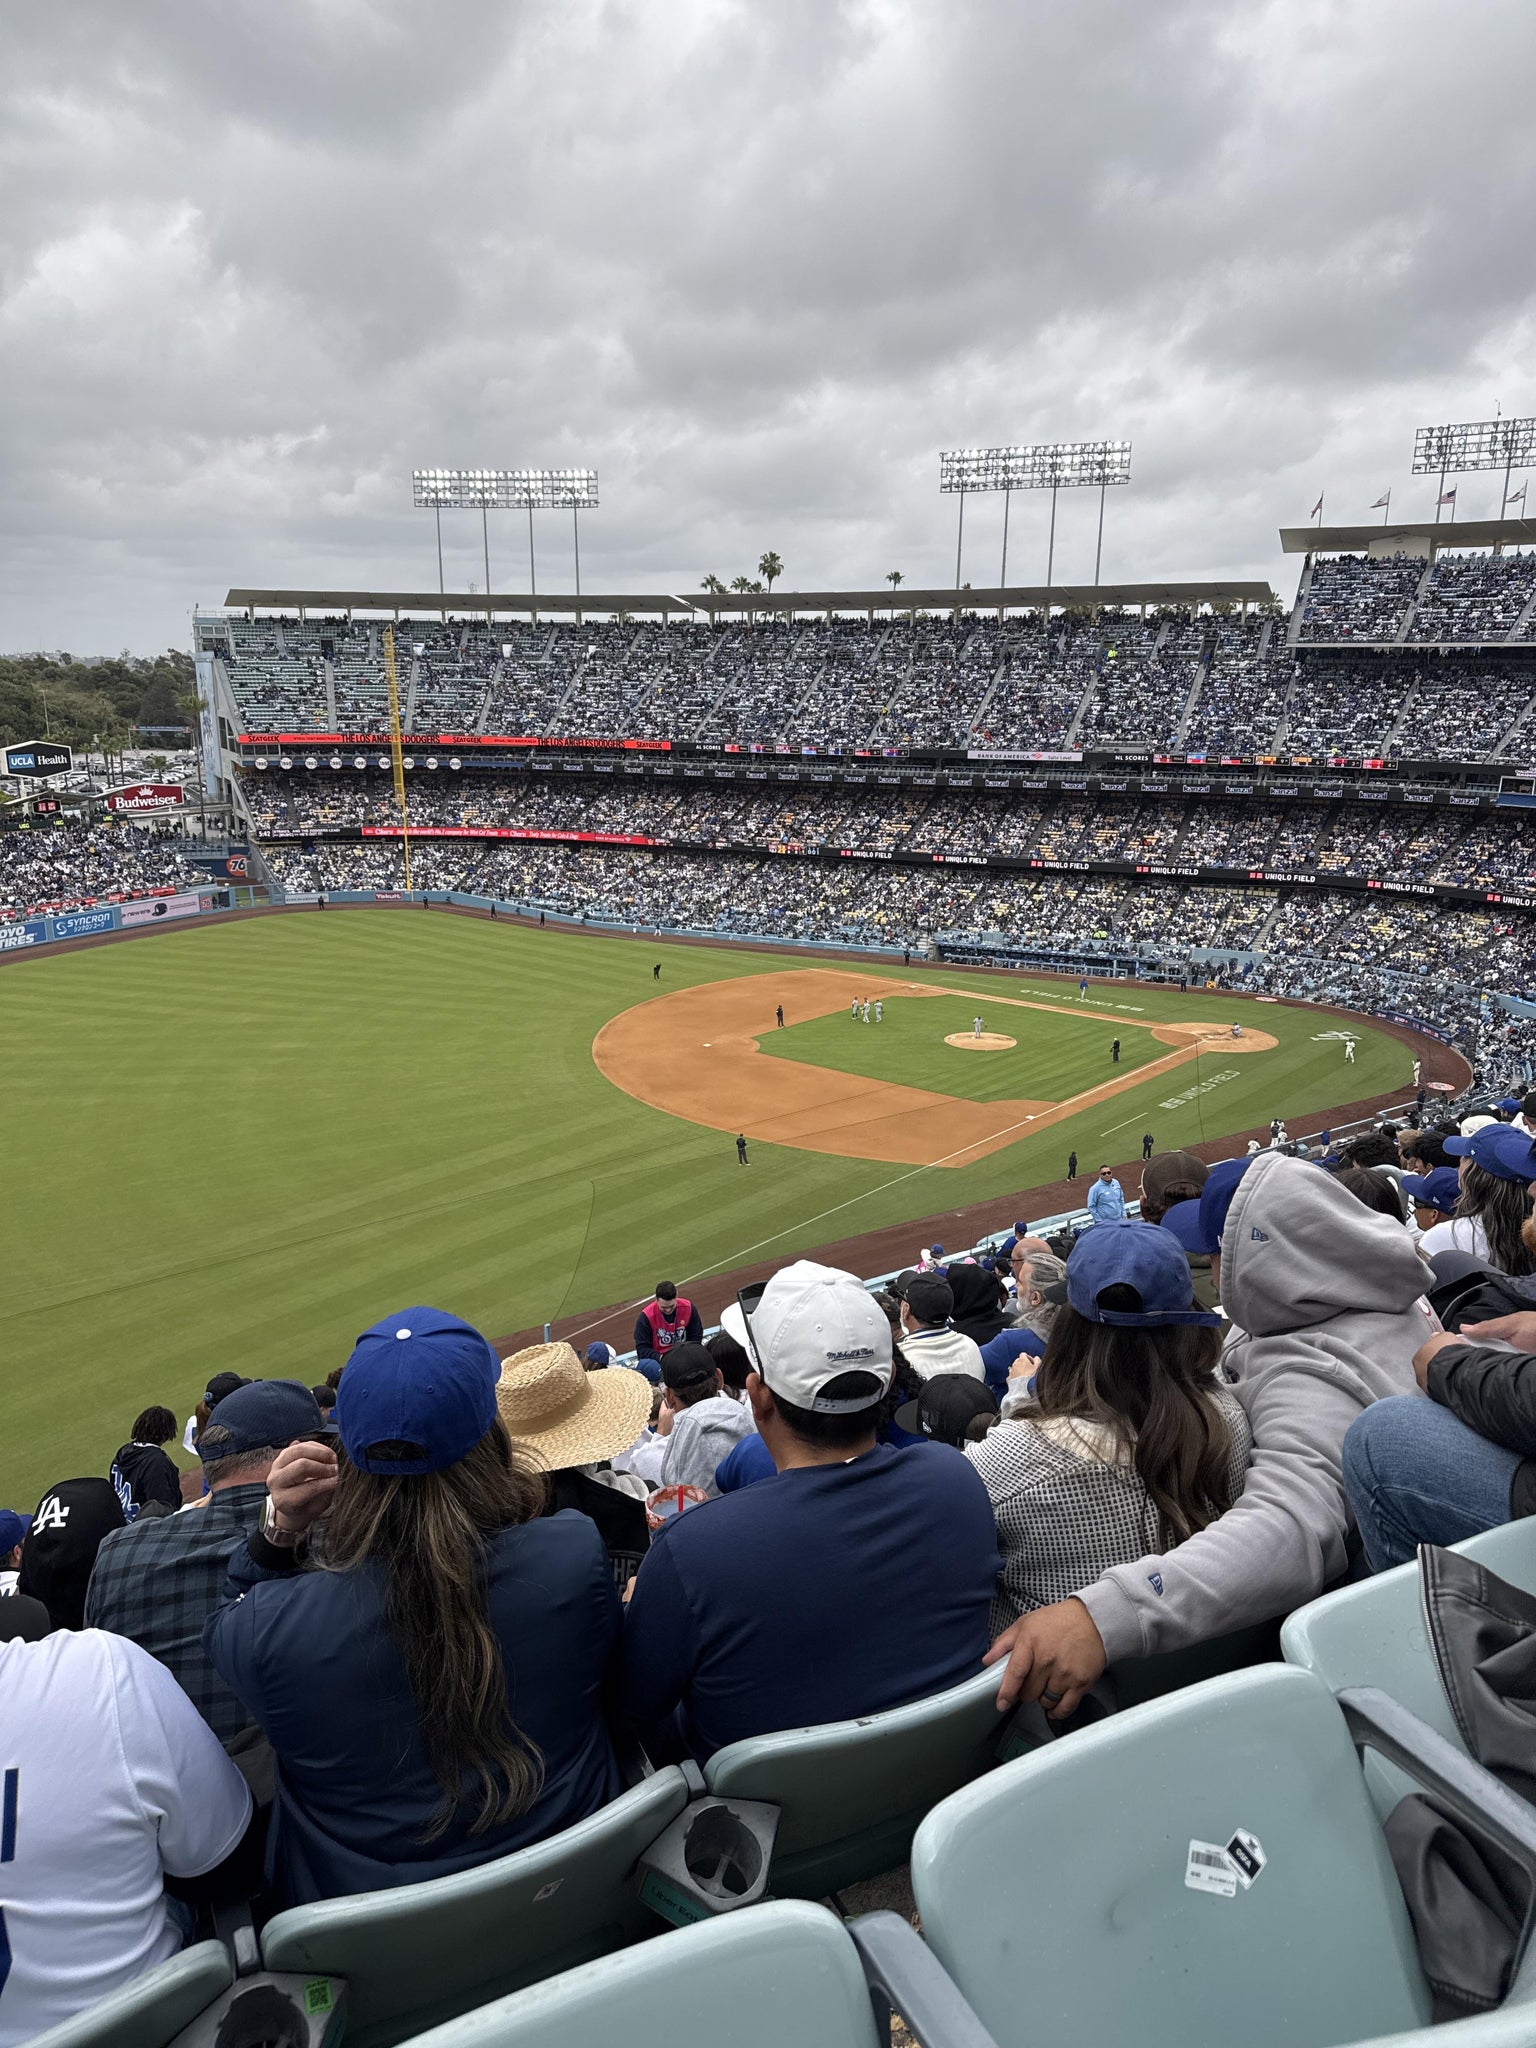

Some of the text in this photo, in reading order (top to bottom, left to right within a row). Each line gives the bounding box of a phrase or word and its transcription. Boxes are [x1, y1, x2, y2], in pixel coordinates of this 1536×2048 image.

[342, 734, 356, 743] THE
[356, 734, 370, 743] LOS
[404, 735, 440, 744] DODGERS
[452, 736, 482, 744] SEATGEEK
[538, 738, 625, 749] THE LOS ANGELES DODGERS
[636, 741, 662, 749] SEATGEEK
[10, 754, 67, 766] UCLA Health
[114, 795, 177, 809] Budweiser
[874, 851, 892, 859] FIELD
[945, 855, 988, 864] UNIQLO FIELD
[231, 859, 246, 870] 76
[1044, 861, 1090, 870] UNIQLO FIELD
[1150, 866, 1199, 875] UNIQLO FIELD
[1264, 872, 1316, 883] UNIQLO FIELD
[1383, 881, 1435, 894] UNIQLO FIELD
[1502, 895, 1530, 906] UNIQLO
[67, 913, 110, 928] SYNCRON
[0, 933, 35, 949] TIRES
[1176, 1070, 1240, 1100] UNIQLO FIELD
[826, 1350, 855, 1360] Mitchell
[32, 1494, 70, 1536] LA
[651, 1886, 700, 1924] Uber Eat
